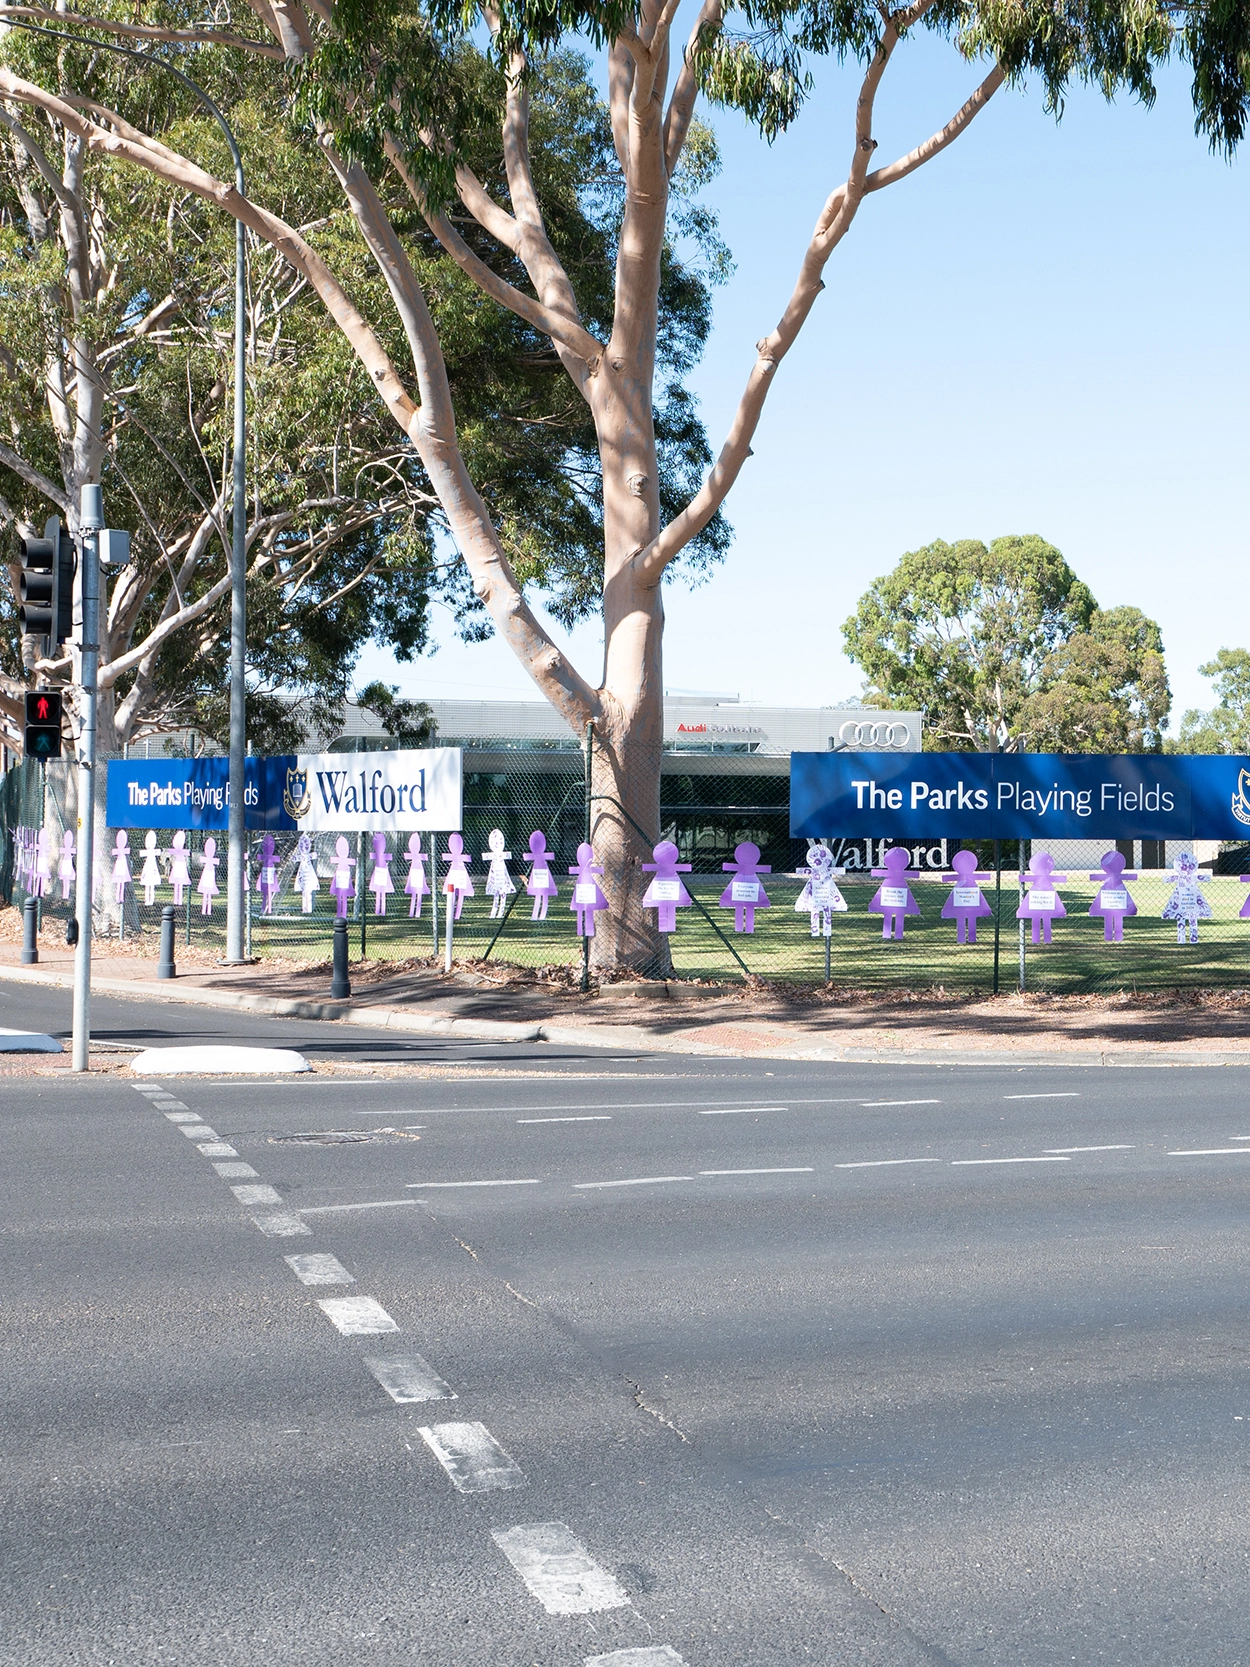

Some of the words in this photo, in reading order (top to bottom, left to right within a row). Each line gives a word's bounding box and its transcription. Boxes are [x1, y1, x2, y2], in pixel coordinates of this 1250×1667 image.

[677, 723, 707, 733] Audi
[127, 781, 149, 806] The
[149, 781, 182, 806] Parks
[183, 781, 224, 811] Playing
[315, 768, 427, 814] Walford
[851, 781, 903, 810] The
[910, 780, 989, 810] Parks
[996, 782, 1093, 817] Playing
[1101, 782, 1175, 812] Fields
